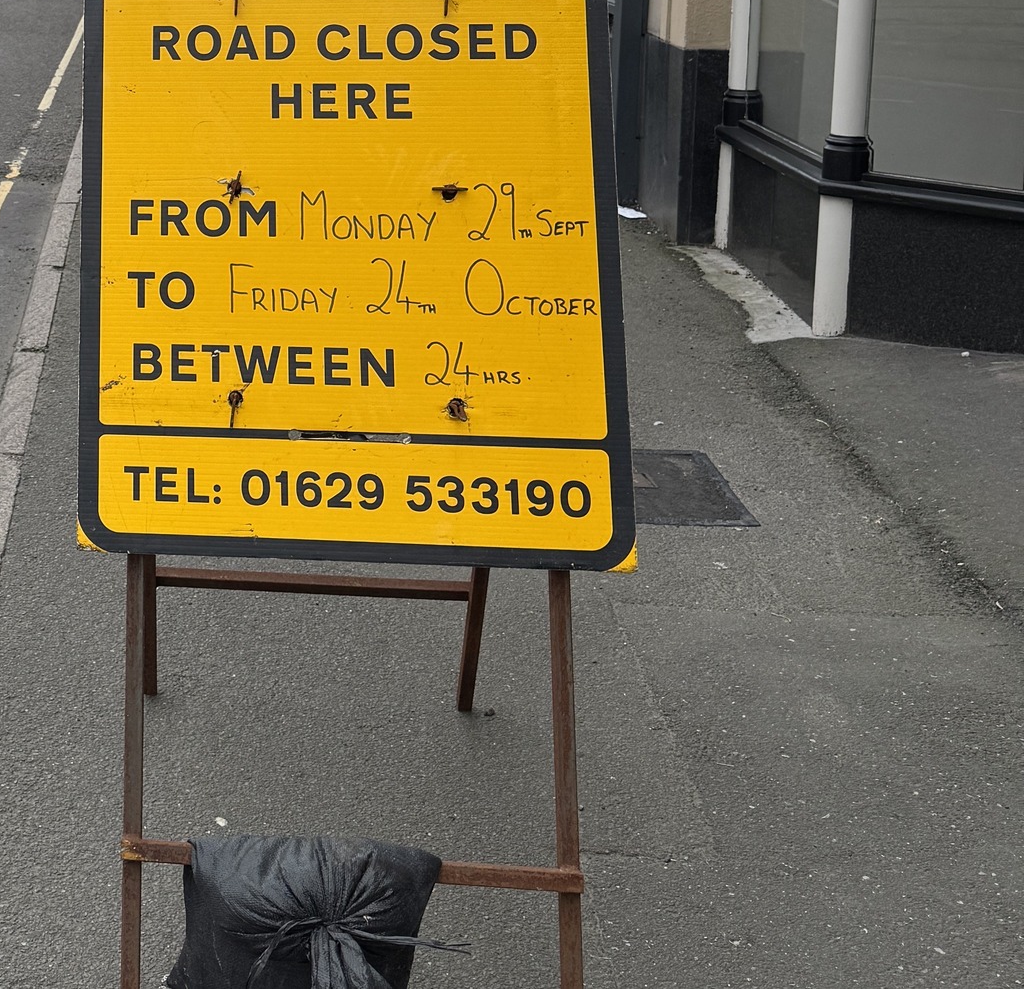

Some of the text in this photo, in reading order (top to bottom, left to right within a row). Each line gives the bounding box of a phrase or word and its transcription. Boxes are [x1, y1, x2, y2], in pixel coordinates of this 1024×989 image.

[153, 24, 537, 61] ROAD CLOSED
[272, 84, 412, 119] HERE
[130, 200, 277, 237] FROM
[128, 272, 195, 309] TO
[132, 343, 395, 387] BETWEEN
[124, 466, 591, 518] TEL: 01629 533190
